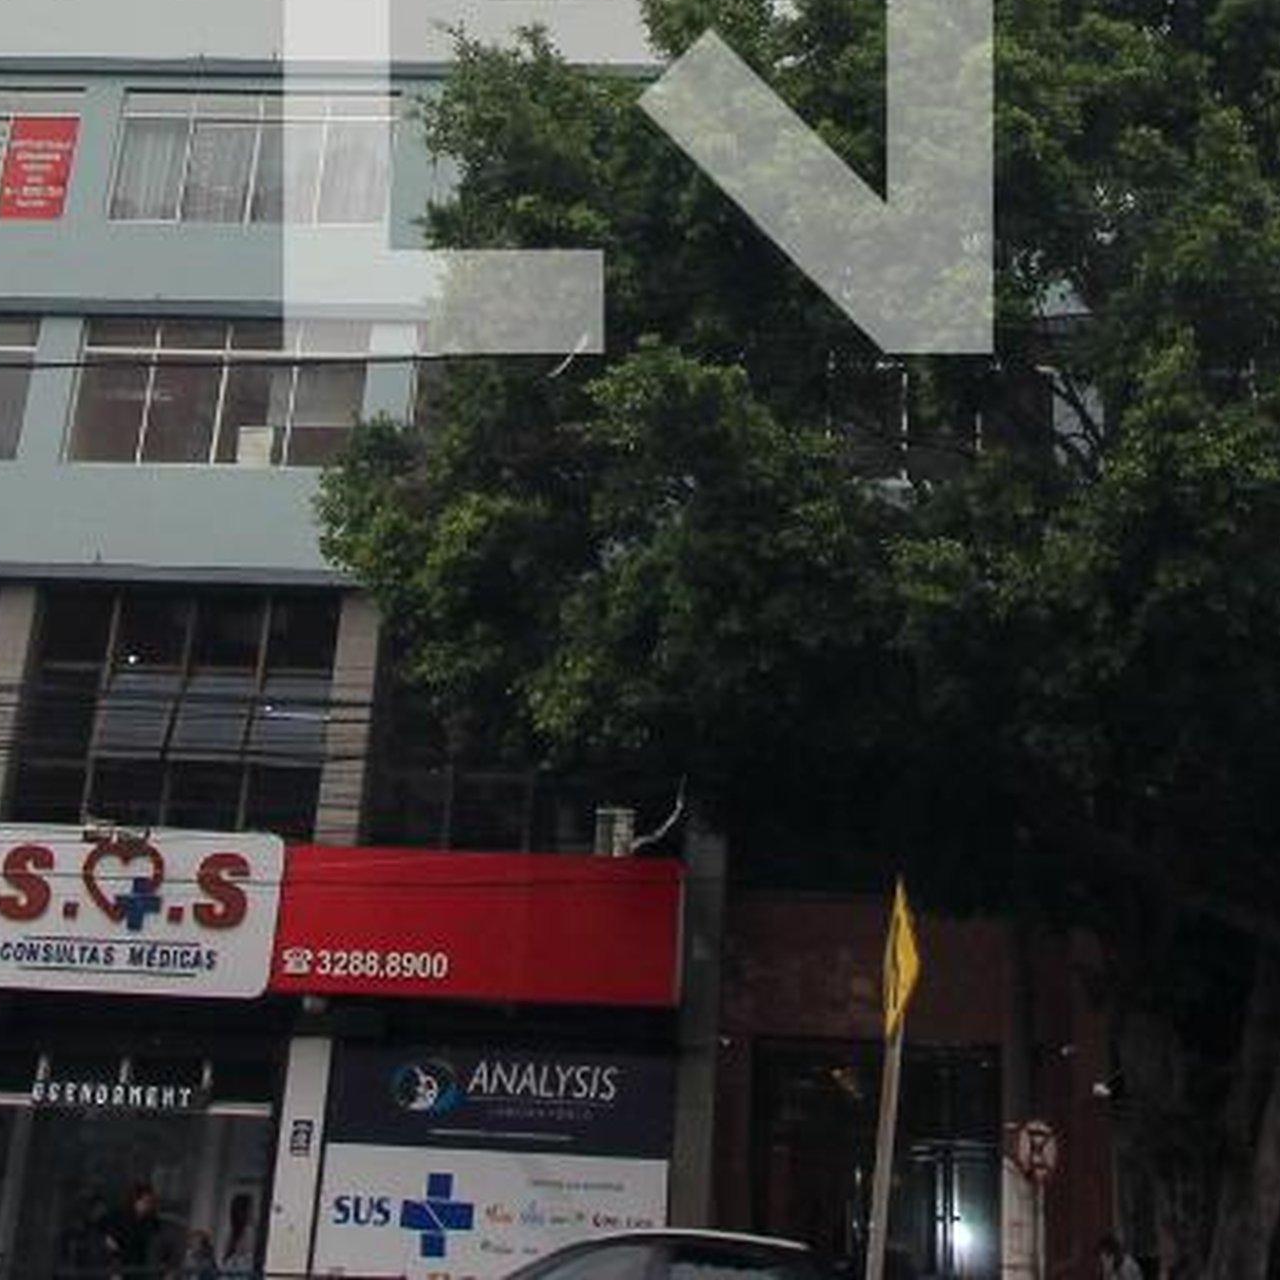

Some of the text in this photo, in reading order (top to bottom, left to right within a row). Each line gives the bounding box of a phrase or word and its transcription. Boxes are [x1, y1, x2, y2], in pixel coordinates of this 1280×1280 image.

[0, 940, 218, 970] CONSULTAS MÉDICAS
[467, 1061, 620, 1101] ANALYSIS
[332, 1194, 392, 1227] SUS
